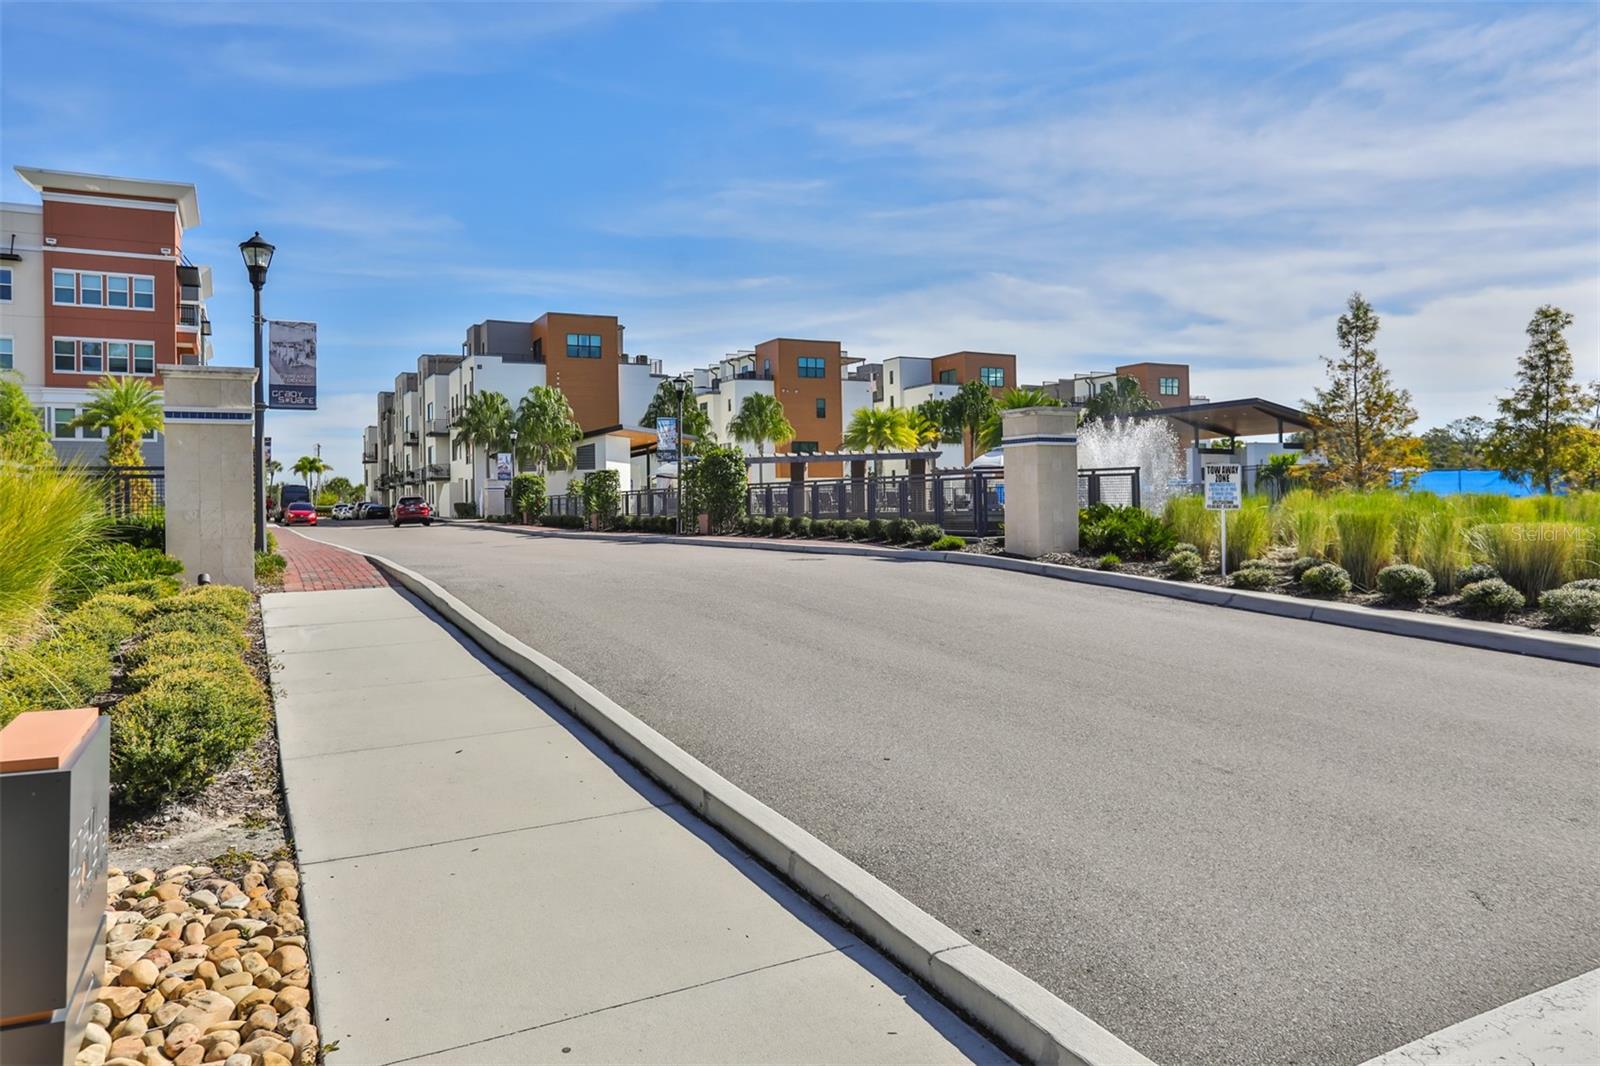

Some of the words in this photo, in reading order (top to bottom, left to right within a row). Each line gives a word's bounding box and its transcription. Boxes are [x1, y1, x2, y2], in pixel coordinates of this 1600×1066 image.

[1207, 465, 1221, 474] TOW
[1222, 465, 1239, 474] AWAY
[1215, 474, 1230, 483] ZONE
